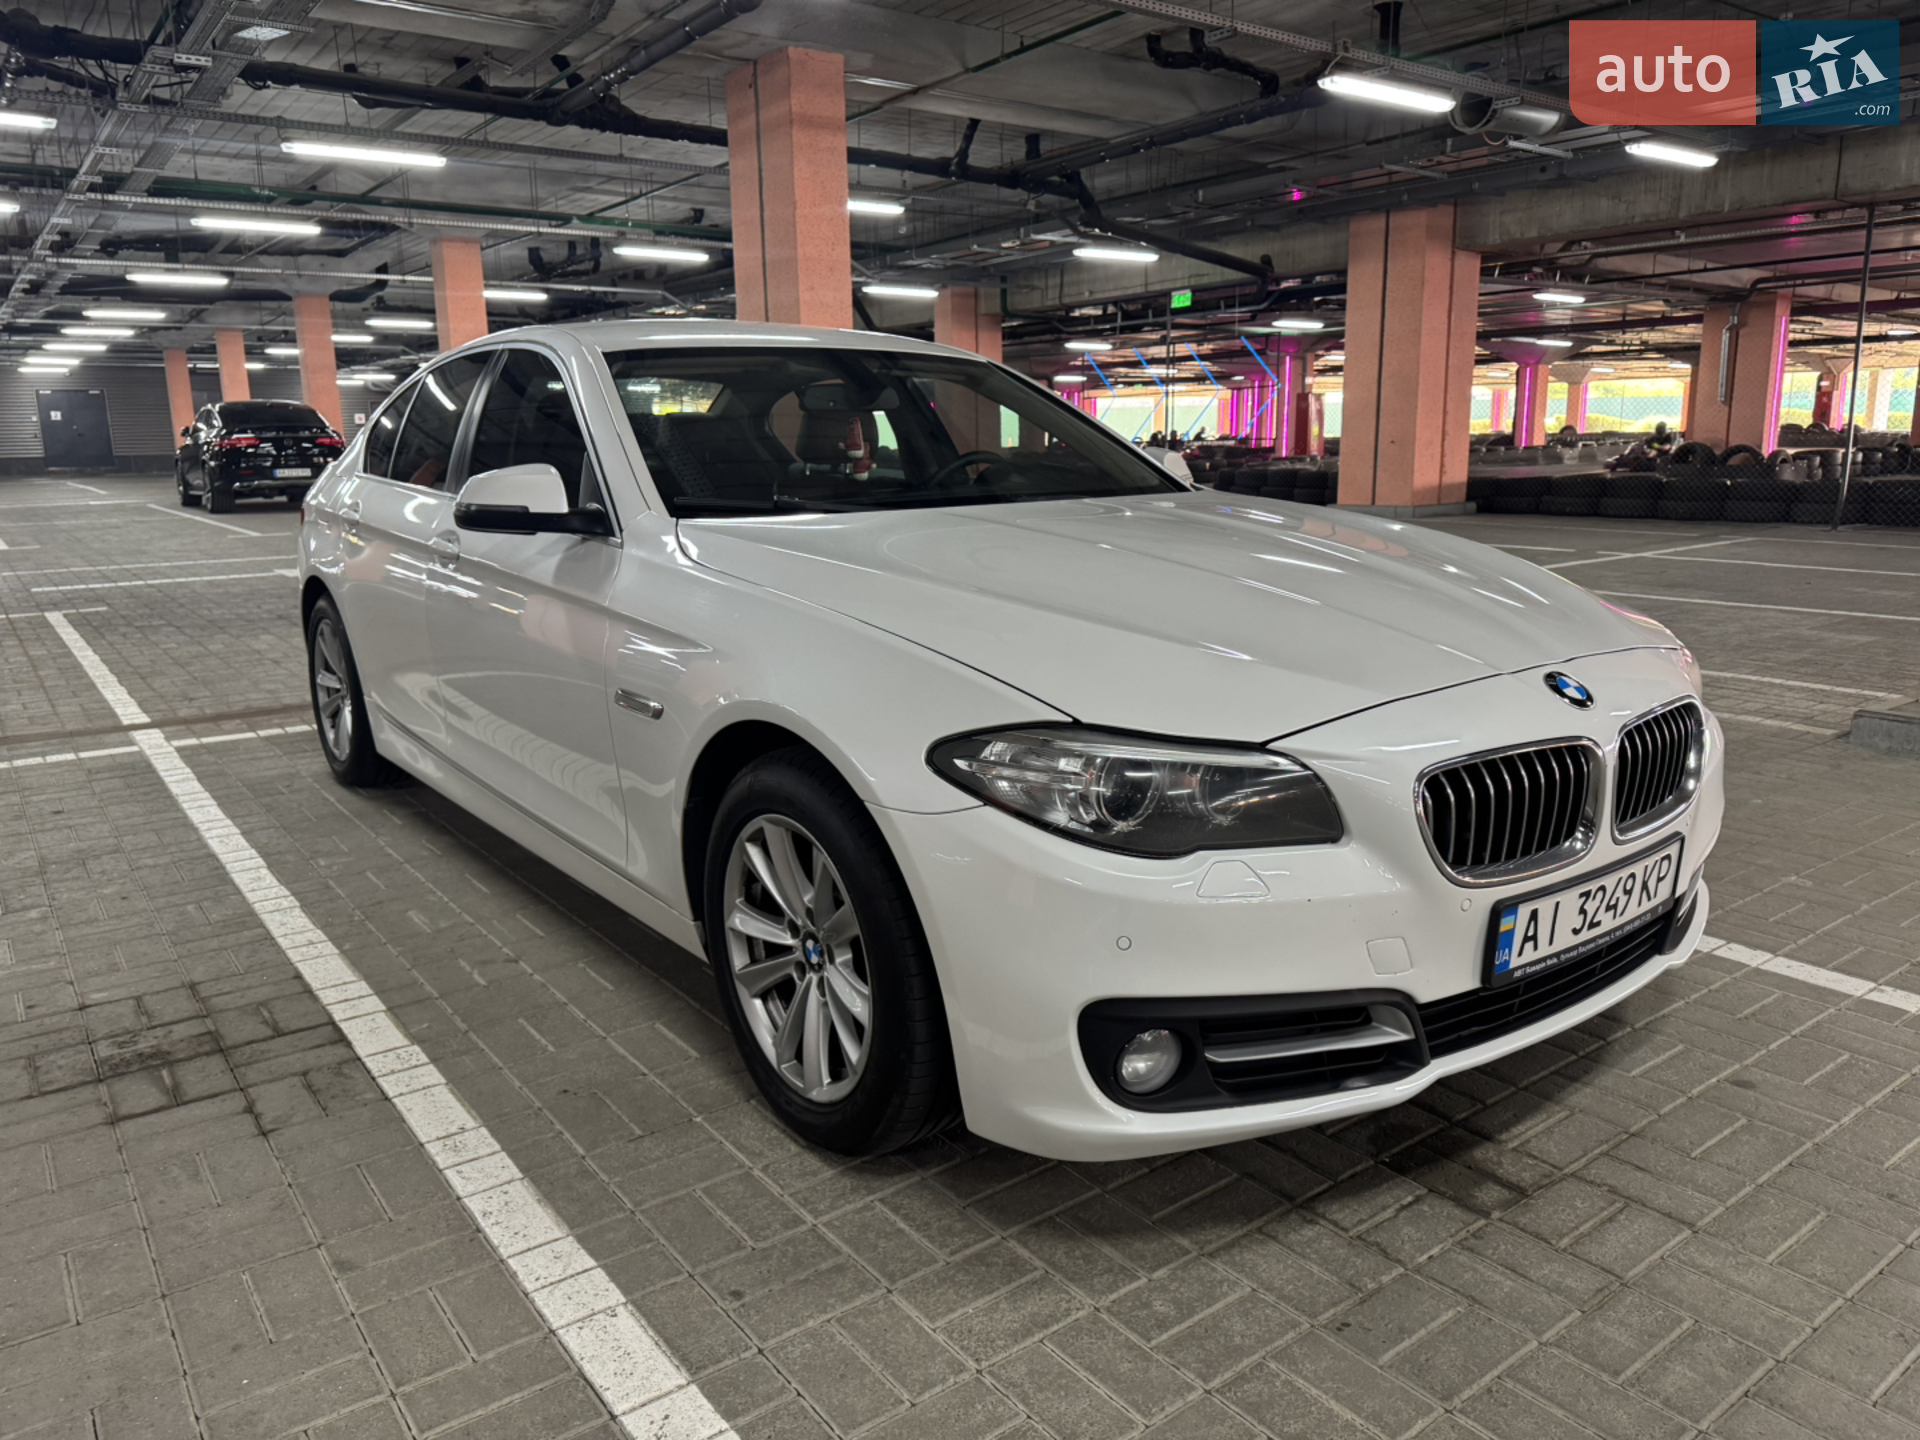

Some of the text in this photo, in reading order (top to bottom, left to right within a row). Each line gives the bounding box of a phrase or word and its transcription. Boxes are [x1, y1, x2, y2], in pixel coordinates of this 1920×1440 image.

[1517, 901, 1560, 957] AI
[1571, 872, 1637, 936] 3249
[1638, 853, 1672, 908] KP
[1495, 949, 1510, 965] UA
